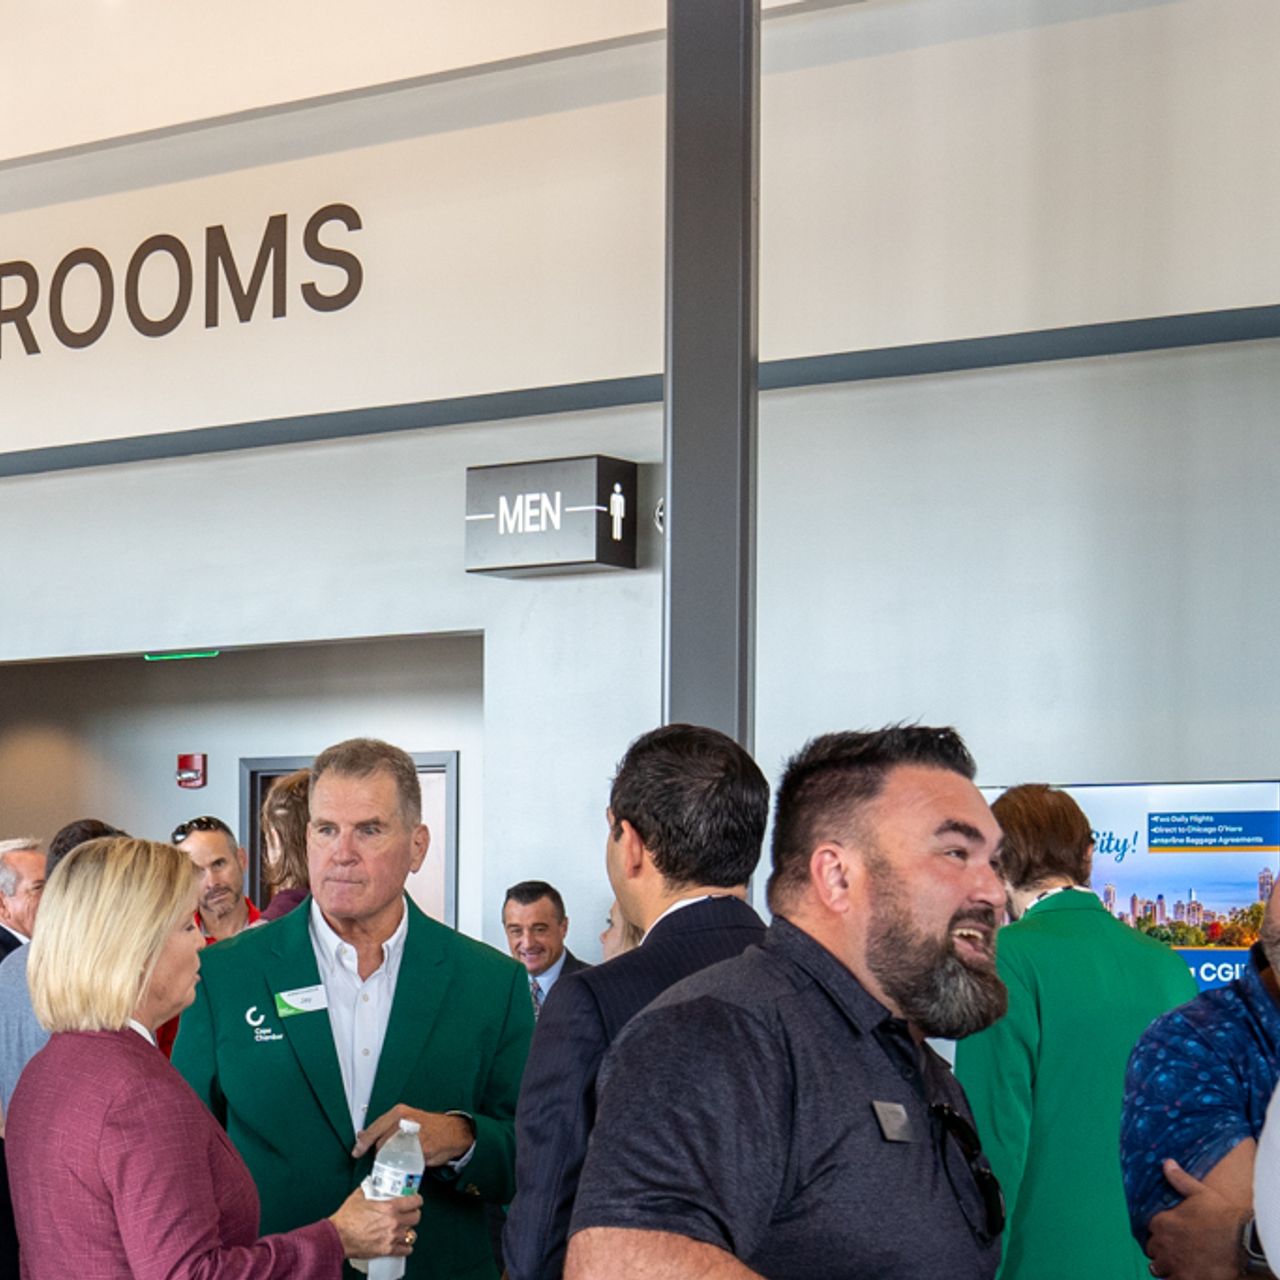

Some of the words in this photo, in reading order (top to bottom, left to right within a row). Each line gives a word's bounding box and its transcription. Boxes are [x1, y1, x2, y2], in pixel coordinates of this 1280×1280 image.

[498, 491, 561, 535] MEN
[1171, 816, 1188, 824] Daily
[1190, 815, 1214, 824] Flights
[1187, 825, 1217, 835] Chicago
[1218, 825, 1243, 833] O'Hare
[1185, 836, 1217, 845] Baggage
[1218, 836, 1264, 845] Agreements
[1094, 831, 1138, 863] ity!
